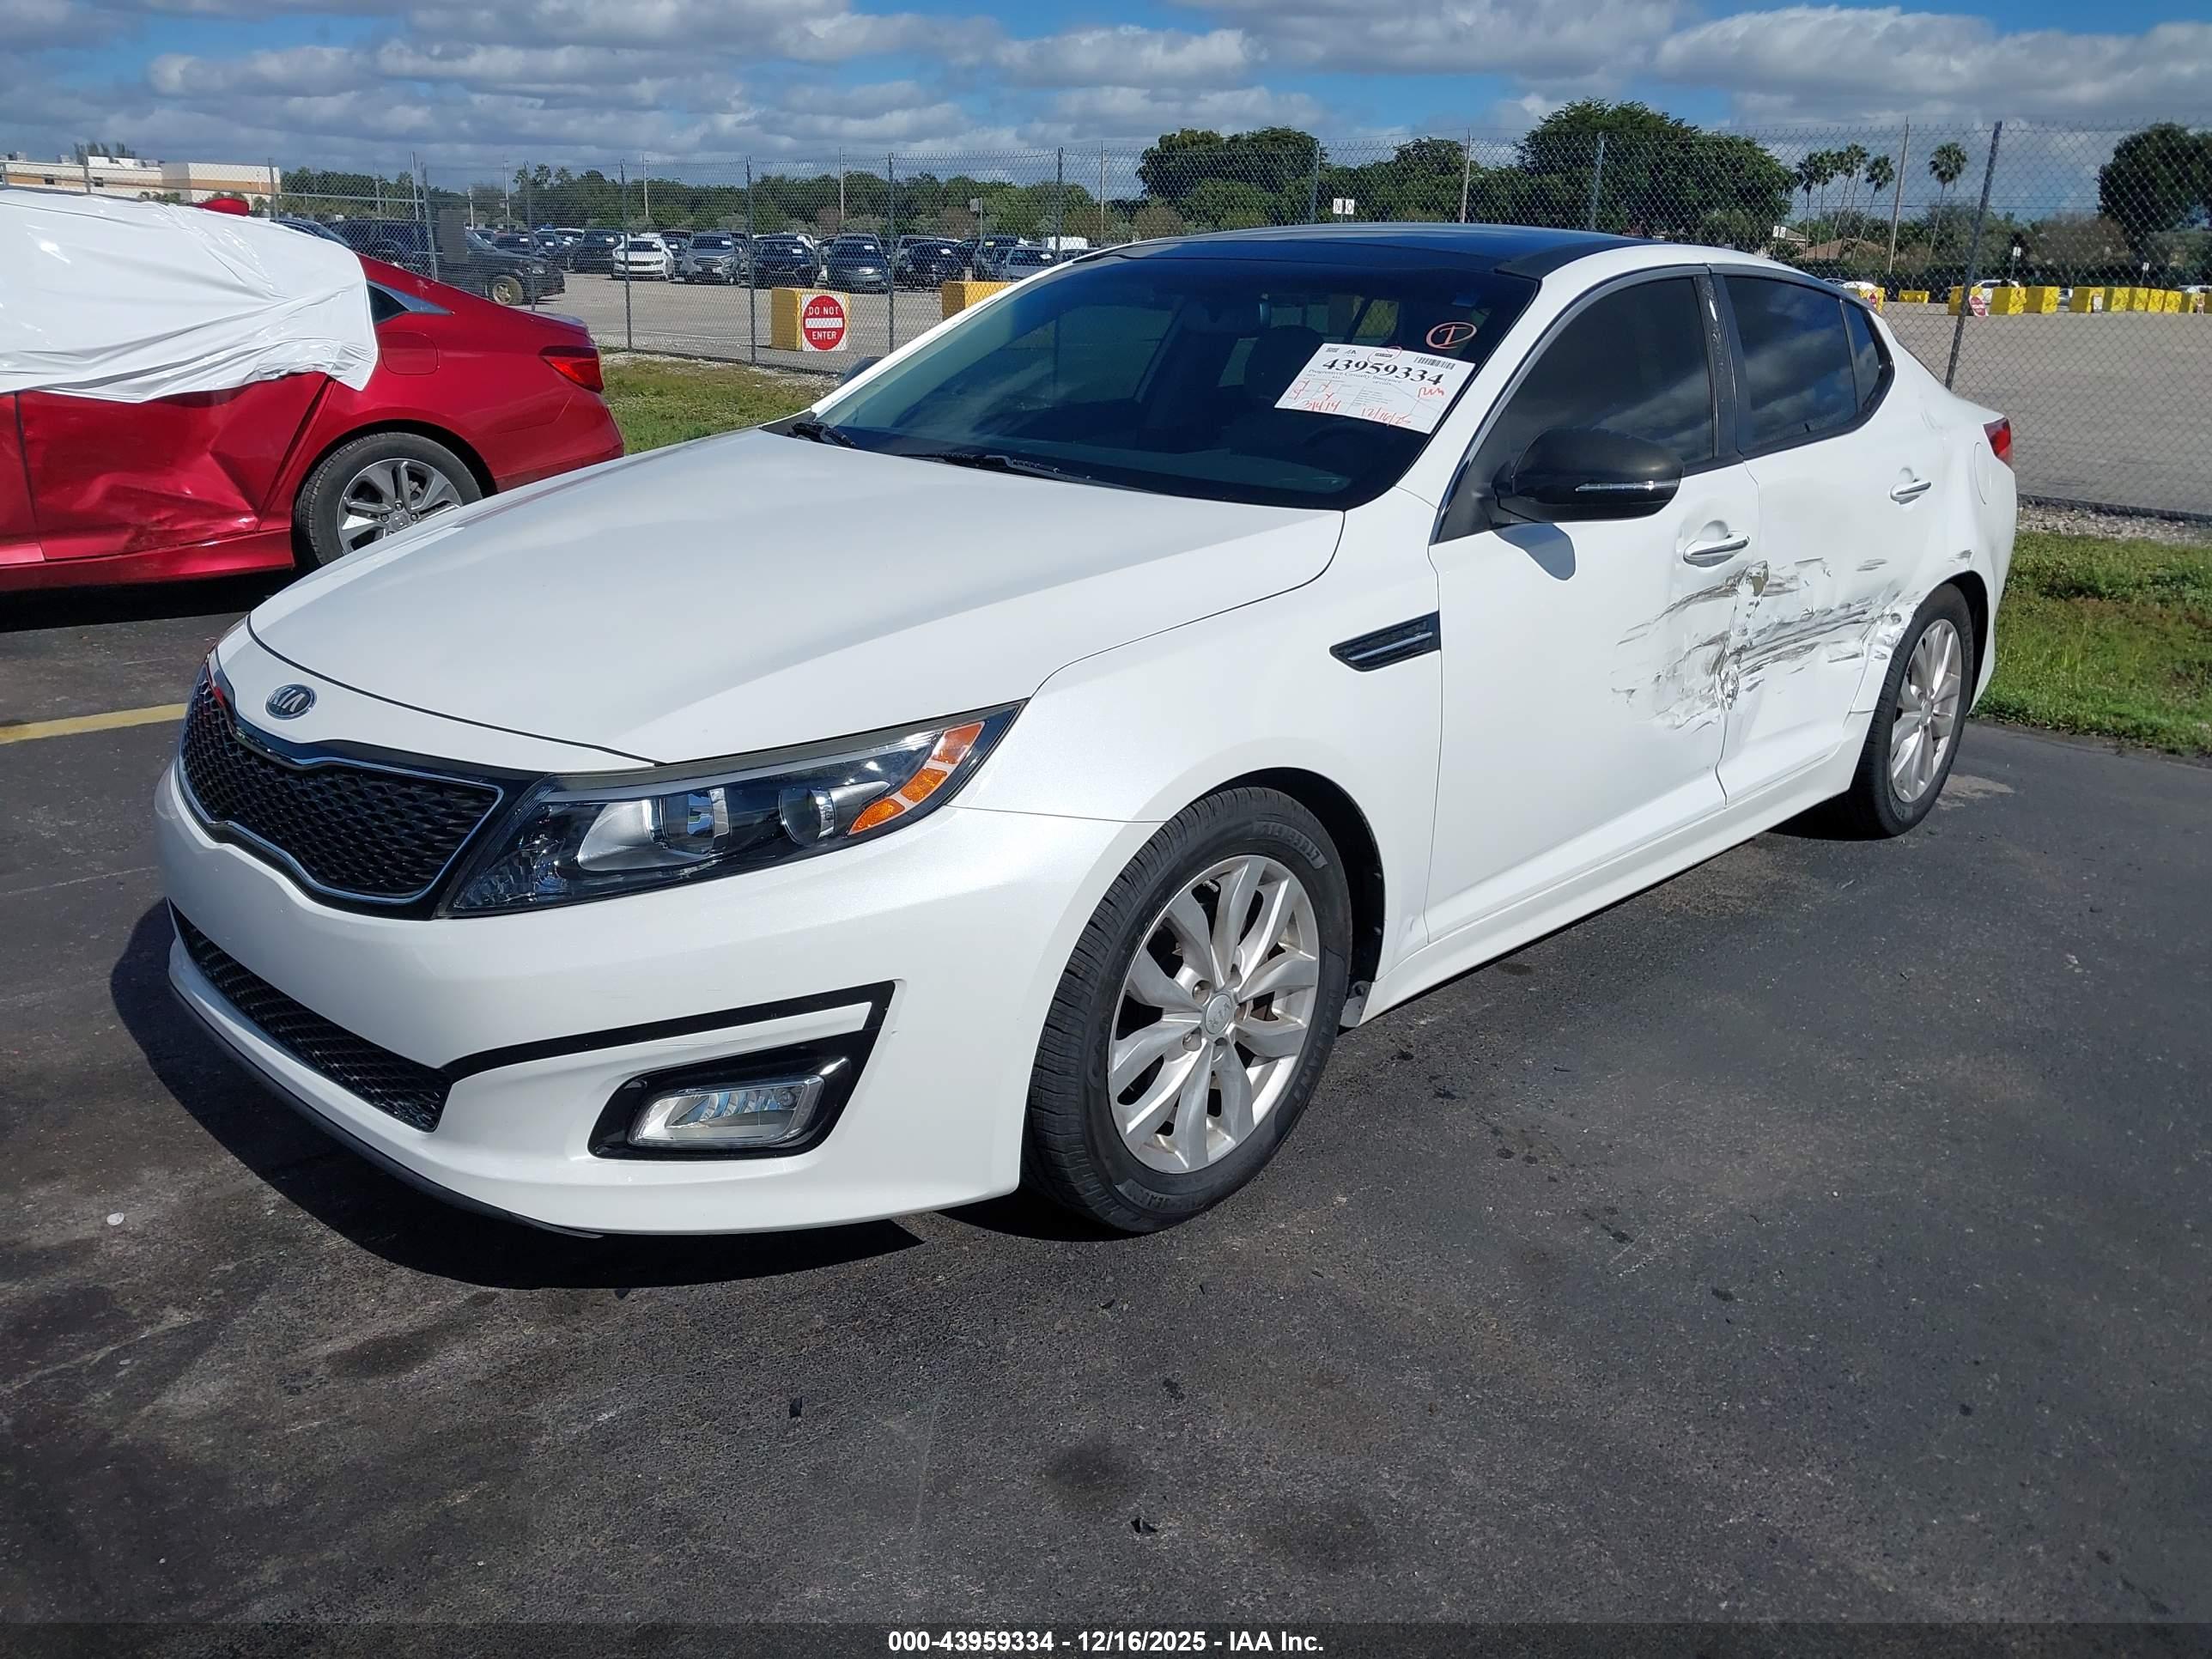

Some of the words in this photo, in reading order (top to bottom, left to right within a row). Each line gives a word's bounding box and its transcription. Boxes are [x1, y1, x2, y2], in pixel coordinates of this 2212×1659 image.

[808, 306, 820, 315] DO
[823, 306, 839, 315] NOT
[811, 331, 836, 340] ENTER
[1322, 358, 1444, 386] 43959334
[1373, 375, 1402, 384] Insurance
